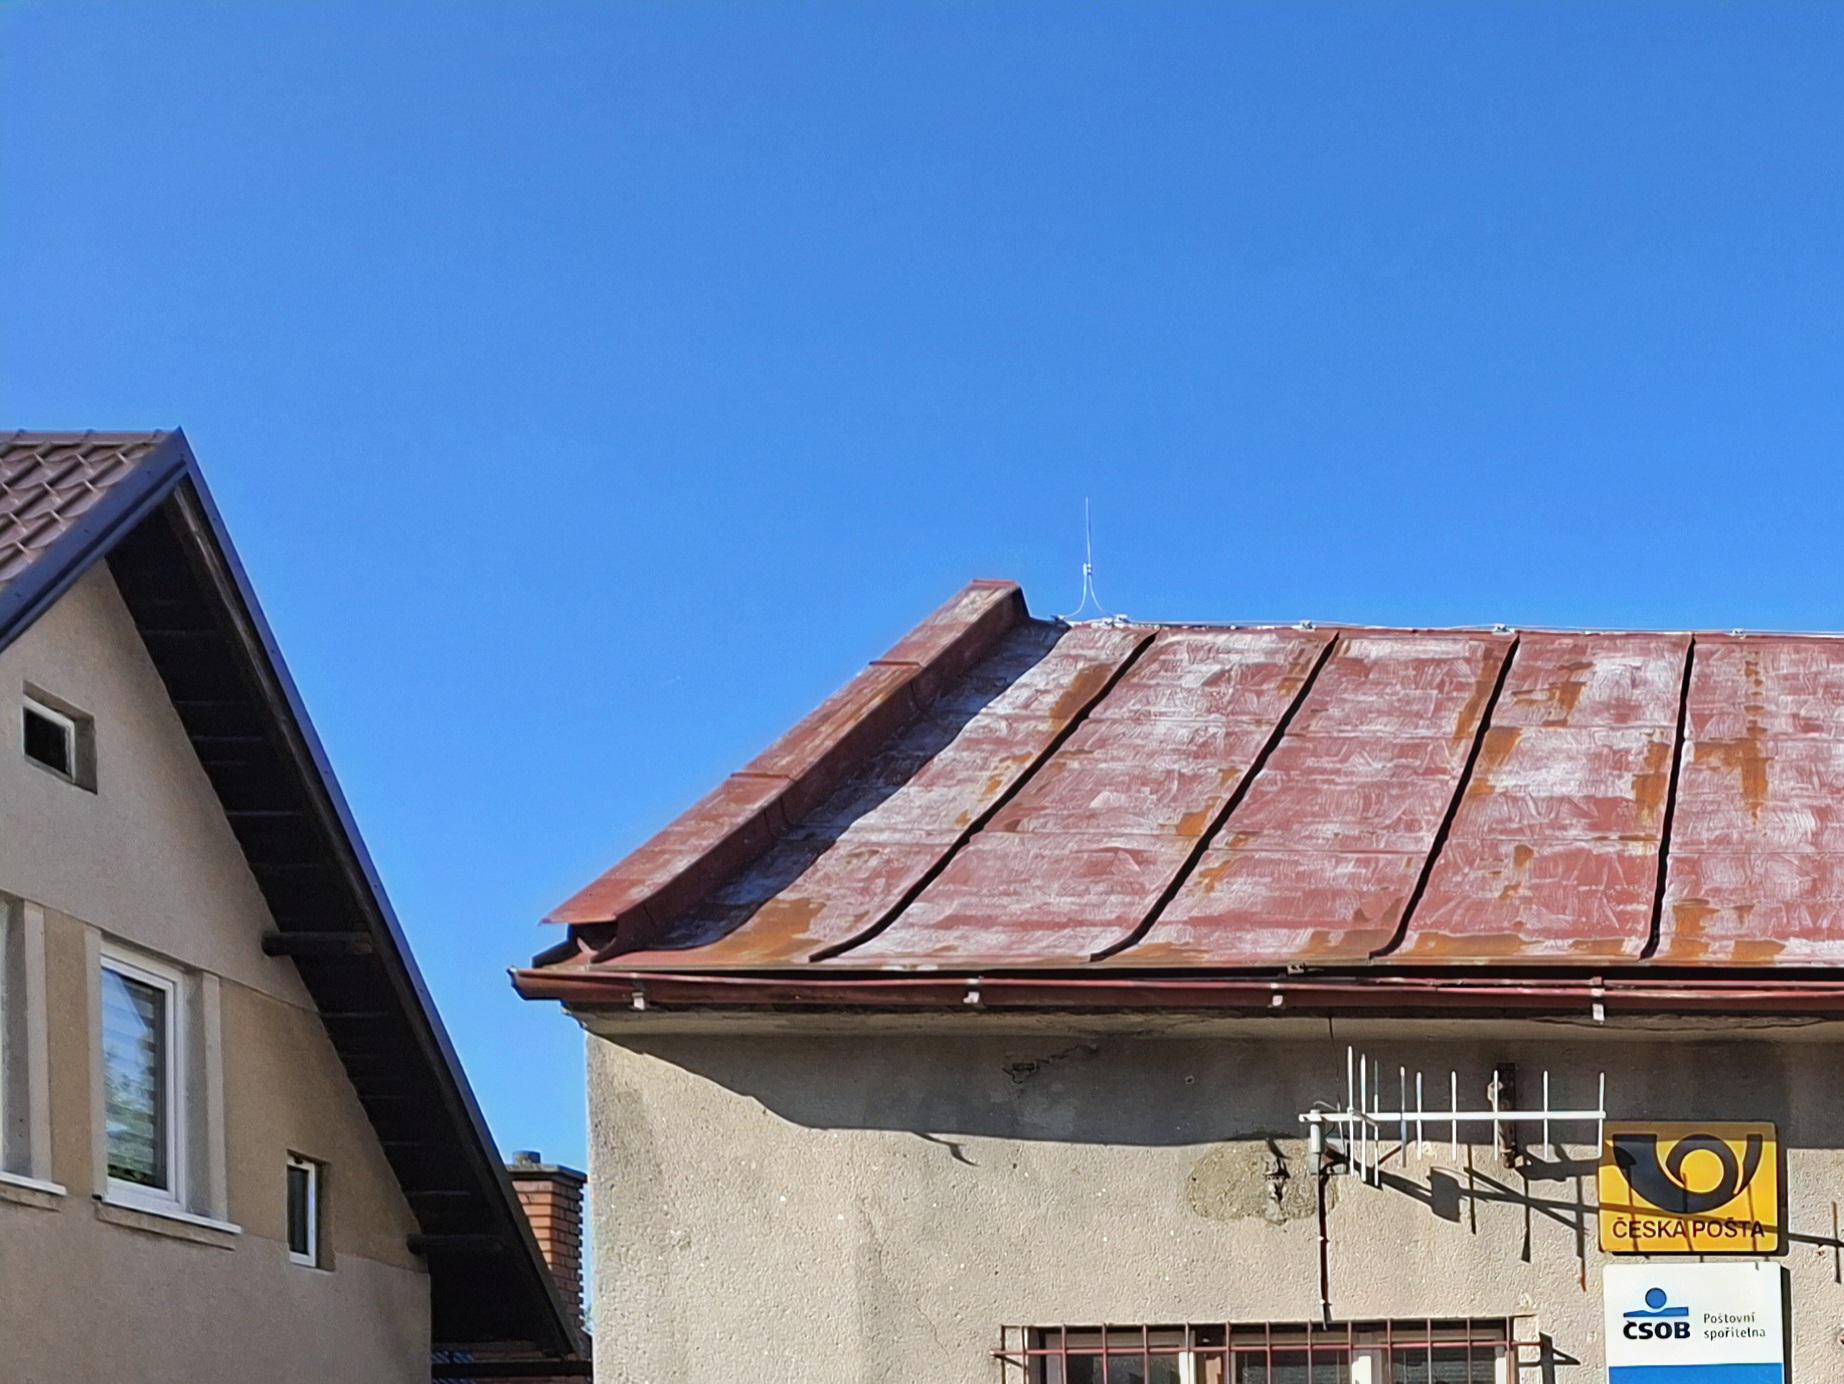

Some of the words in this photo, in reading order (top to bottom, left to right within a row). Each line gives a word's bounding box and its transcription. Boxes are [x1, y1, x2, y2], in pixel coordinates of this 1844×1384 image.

[1612, 1216, 1687, 1238] ČESKÁ
[1692, 1217, 1765, 1238] POŠTA
[1703, 1311, 1756, 1324] Poštovní
[1622, 1319, 1691, 1340] ČSOB
[1703, 1325, 1766, 1342] spořitelna
